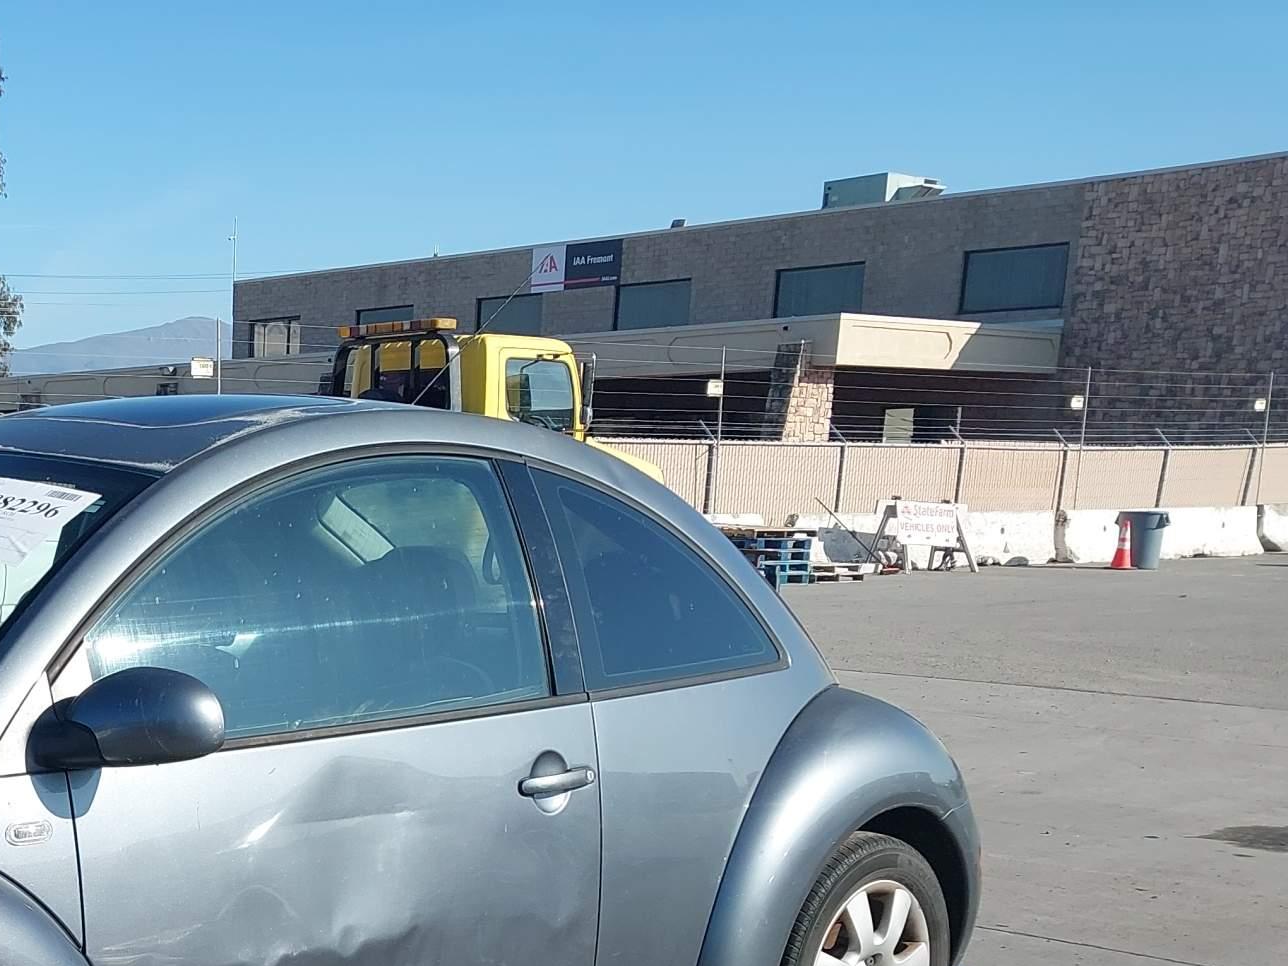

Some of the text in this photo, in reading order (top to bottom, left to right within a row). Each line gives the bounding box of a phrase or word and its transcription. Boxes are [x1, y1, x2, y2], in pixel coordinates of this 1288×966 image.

[573, 254, 614, 266] IAA Fremont
[900, 522, 955, 534] VEHICLES ONLY
